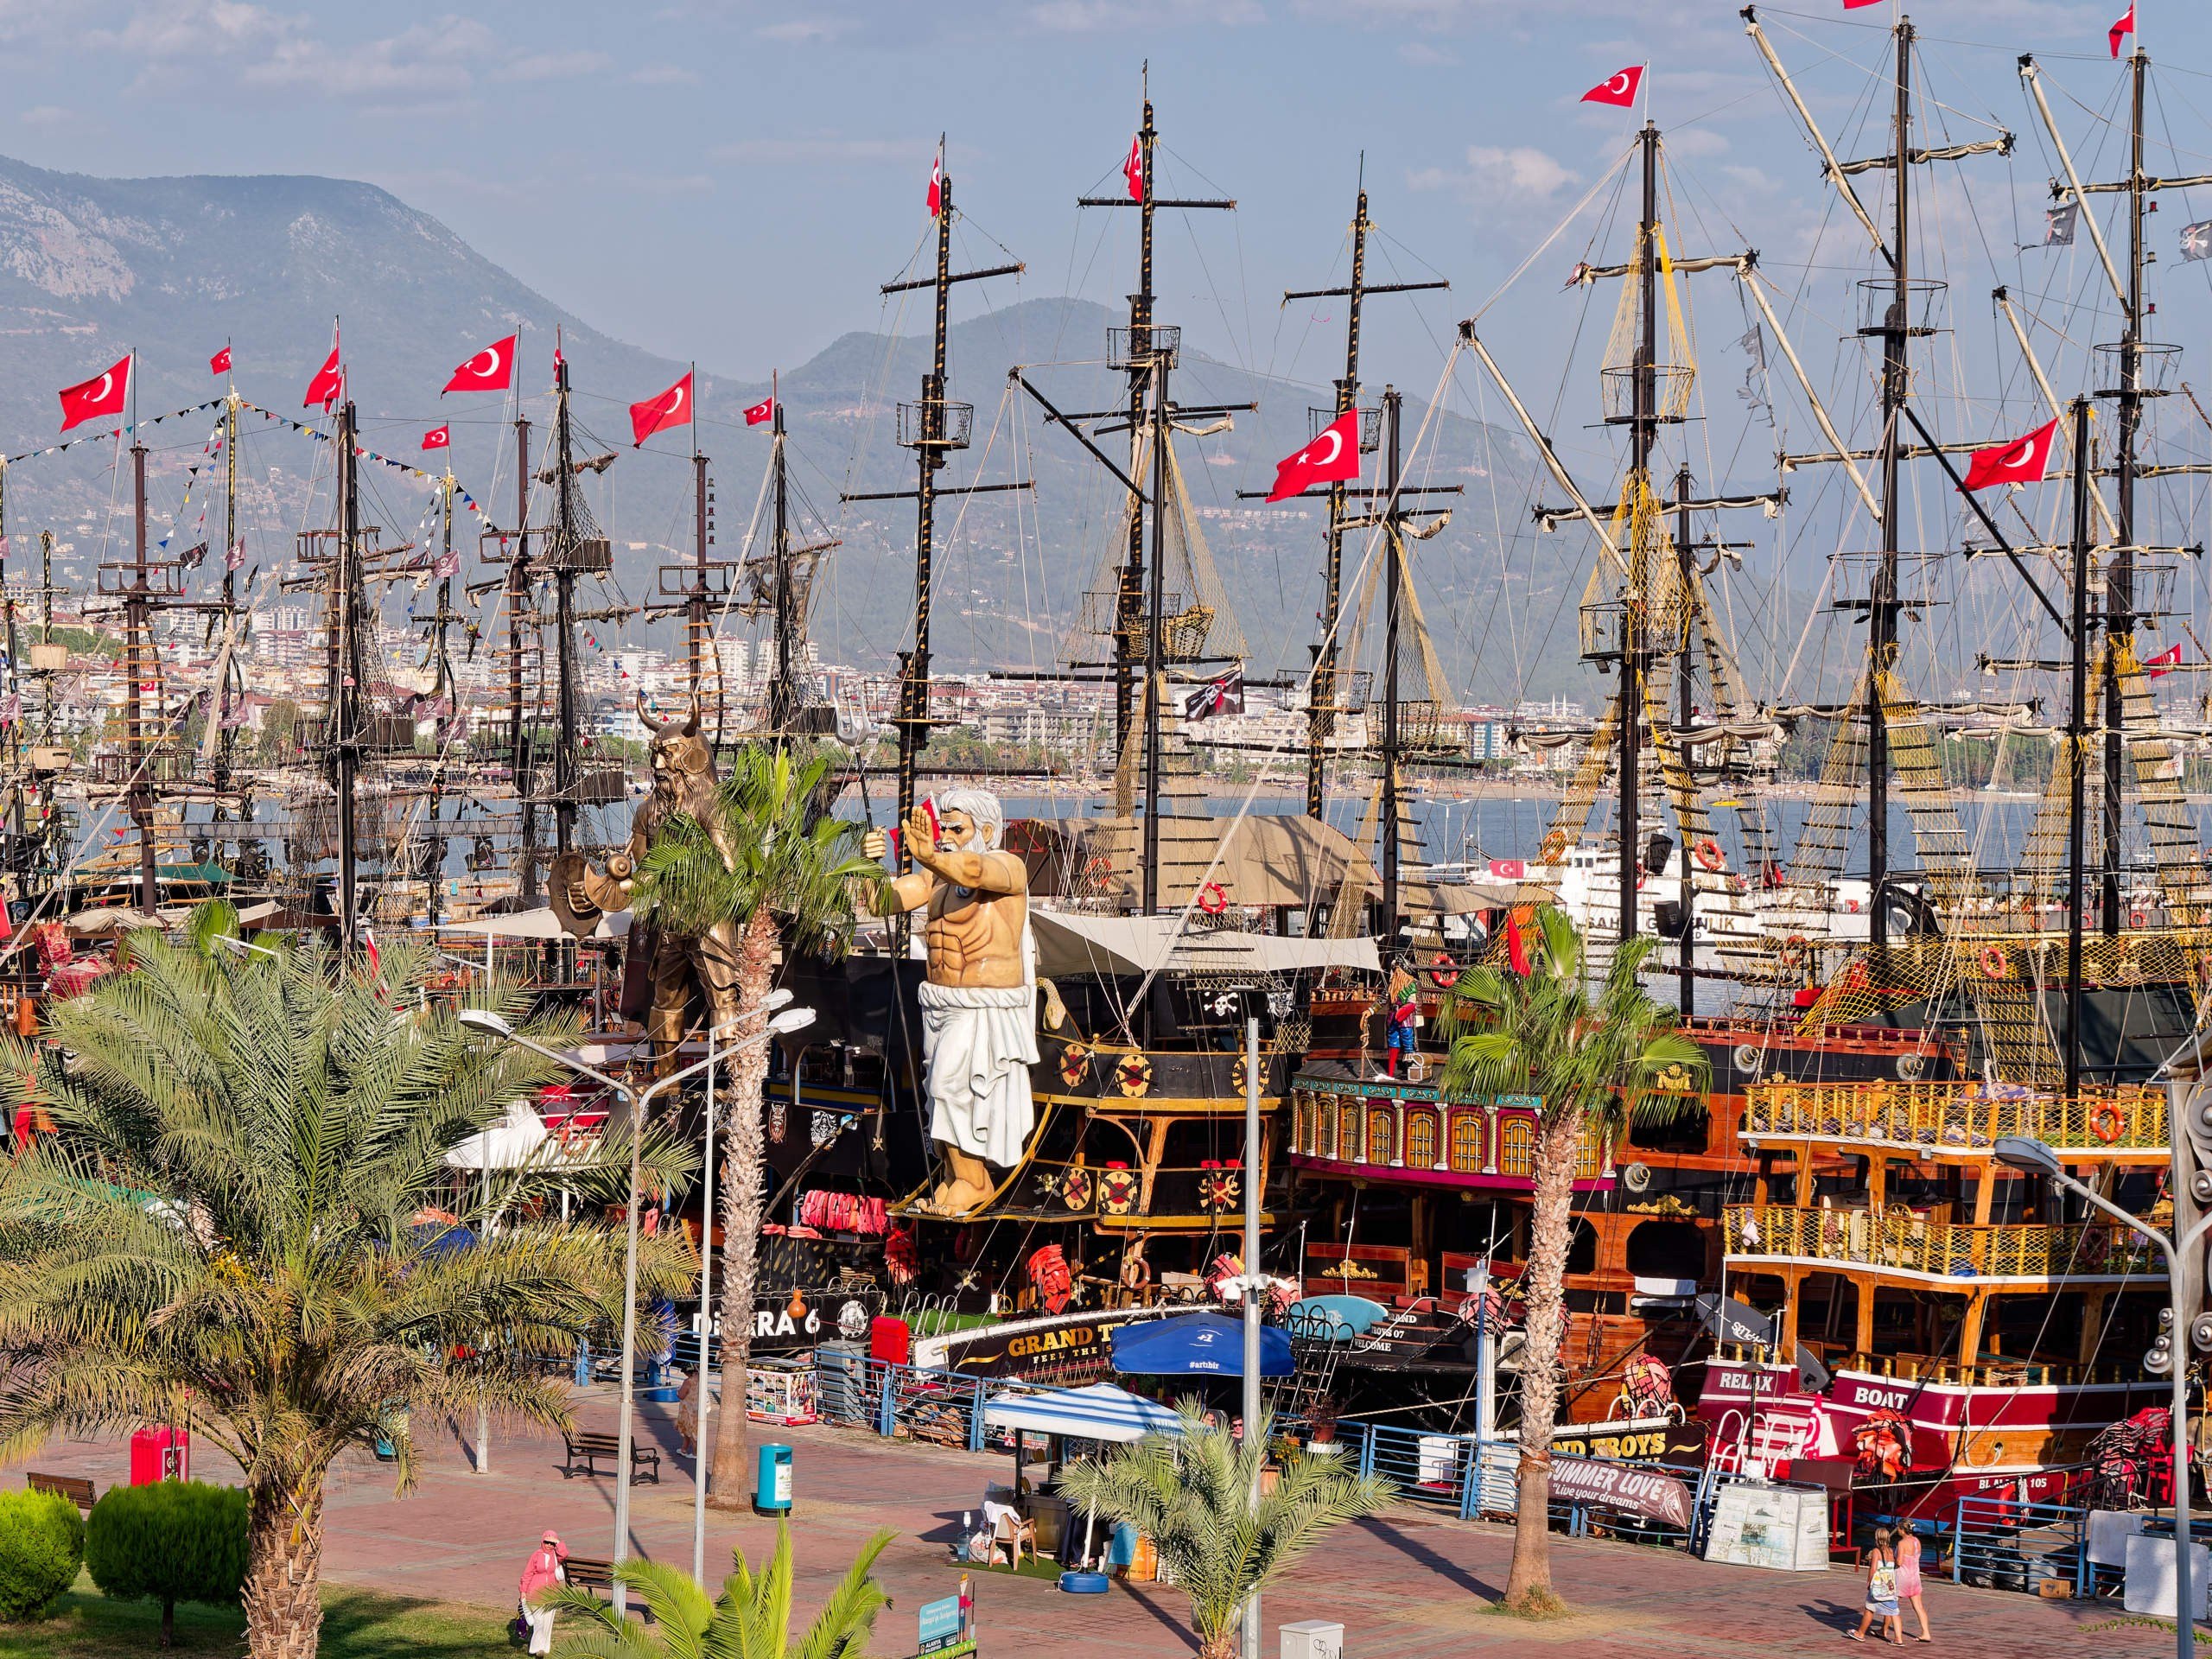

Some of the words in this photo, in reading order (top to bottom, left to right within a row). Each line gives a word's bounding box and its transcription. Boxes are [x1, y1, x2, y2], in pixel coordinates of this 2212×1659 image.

[804, 1308, 822, 1334] 6
[1007, 1326, 1093, 1357] GRAND
[1354, 1338, 1392, 1351] WELCOME
[1393, 1330, 1405, 1338] 07
[1033, 1351, 1065, 1364] FEEL
[1072, 1346, 1097, 1357] THE
[1719, 1371, 1774, 1392] RELAX
[1853, 1386, 1909, 1410] BOAT
[1590, 1432, 1666, 1459] TROYS
[1547, 1459, 1619, 1491] SUMMER
[1618, 1471, 1666, 1501] LOVE
[2030, 1478, 2048, 1488] 105
[1575, 1489, 1599, 1501] your
